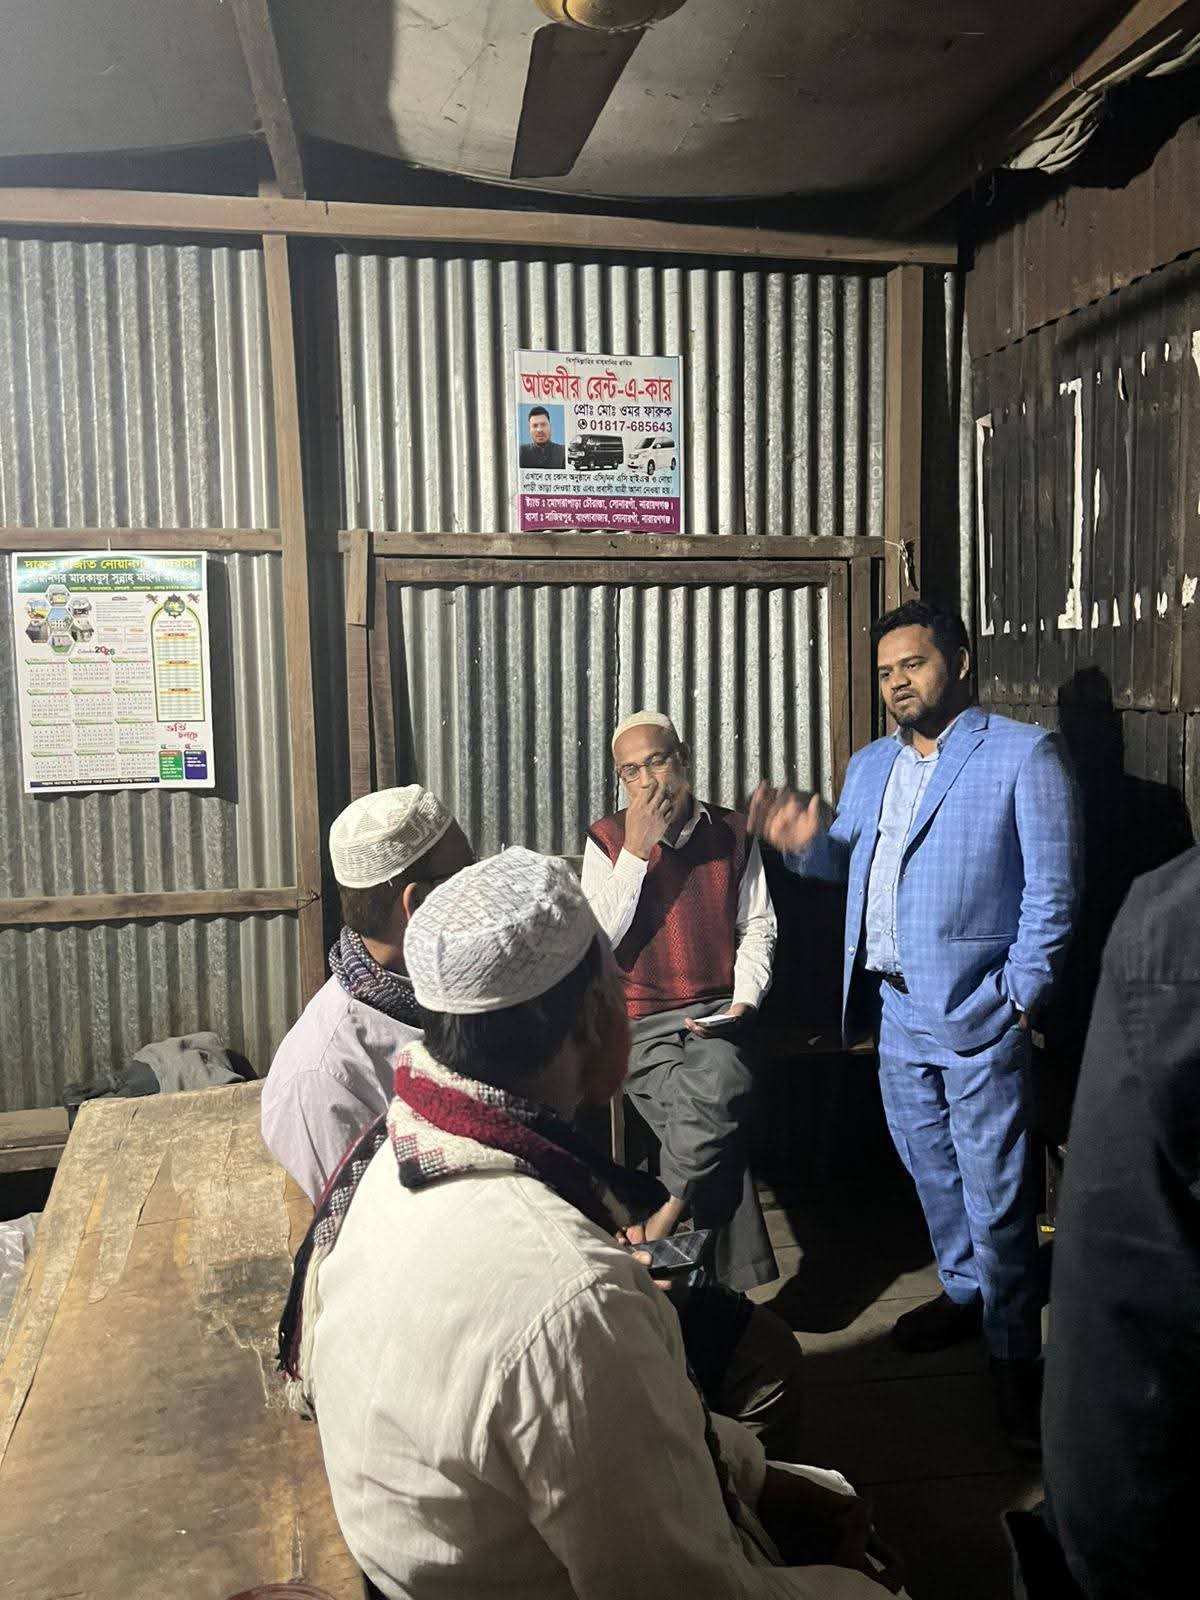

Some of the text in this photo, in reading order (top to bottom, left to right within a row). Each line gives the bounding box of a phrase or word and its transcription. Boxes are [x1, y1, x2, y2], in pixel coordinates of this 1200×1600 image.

[520, 365, 673, 402] আজমীর রেন্ট-এ-কার
[574, 404, 673, 417] প্রোঃ মোঃ ওমর ফারুক
[590, 419, 673, 432] 01817-685643
